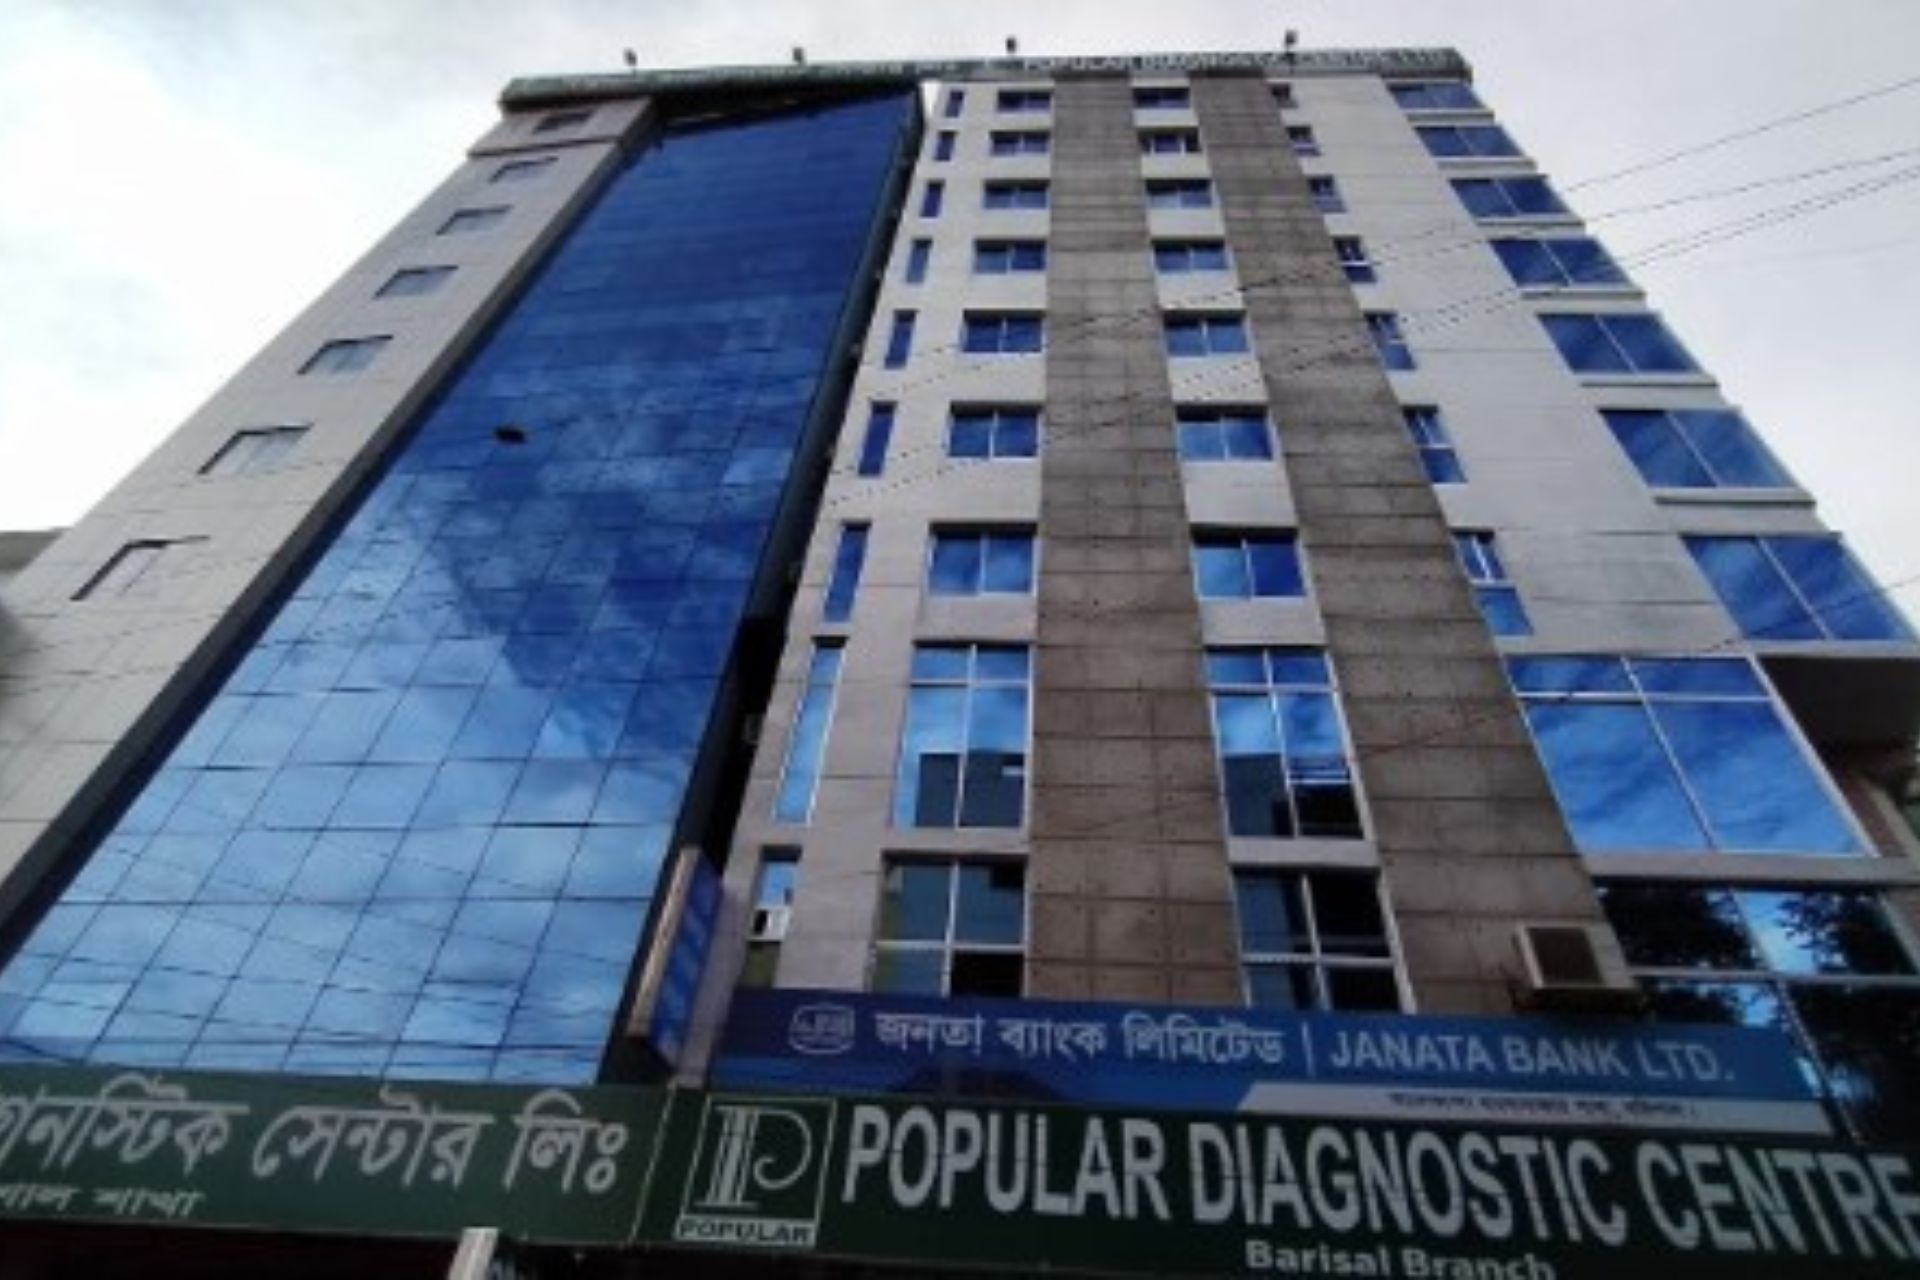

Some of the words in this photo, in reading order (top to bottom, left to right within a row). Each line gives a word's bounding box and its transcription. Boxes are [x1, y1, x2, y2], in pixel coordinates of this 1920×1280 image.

[875, 1012, 984, 1055] জনতা
[1000, 1017, 1107, 1061] ব্যাংক
[1121, 1010, 1286, 1064] লিমিটেড
[1330, 1029, 1495, 1072] JANATA
[1503, 1035, 1630, 1079] BANK
[1638, 1043, 1736, 1082] LTD.
[252, 1085, 494, 1189] সেন্টার
[504, 1089, 628, 1194] লিঃ
[843, 1105, 1172, 1221] POPULAR
[1189, 1120, 1627, 1246] DIAGNOSTIC
[1636, 1141, 1920, 1259] CENTRE
[680, 1219, 810, 1242] POPULAR
[1245, 1240, 1391, 1276] Barisal
[1401, 1247, 1557, 1280] Branch
